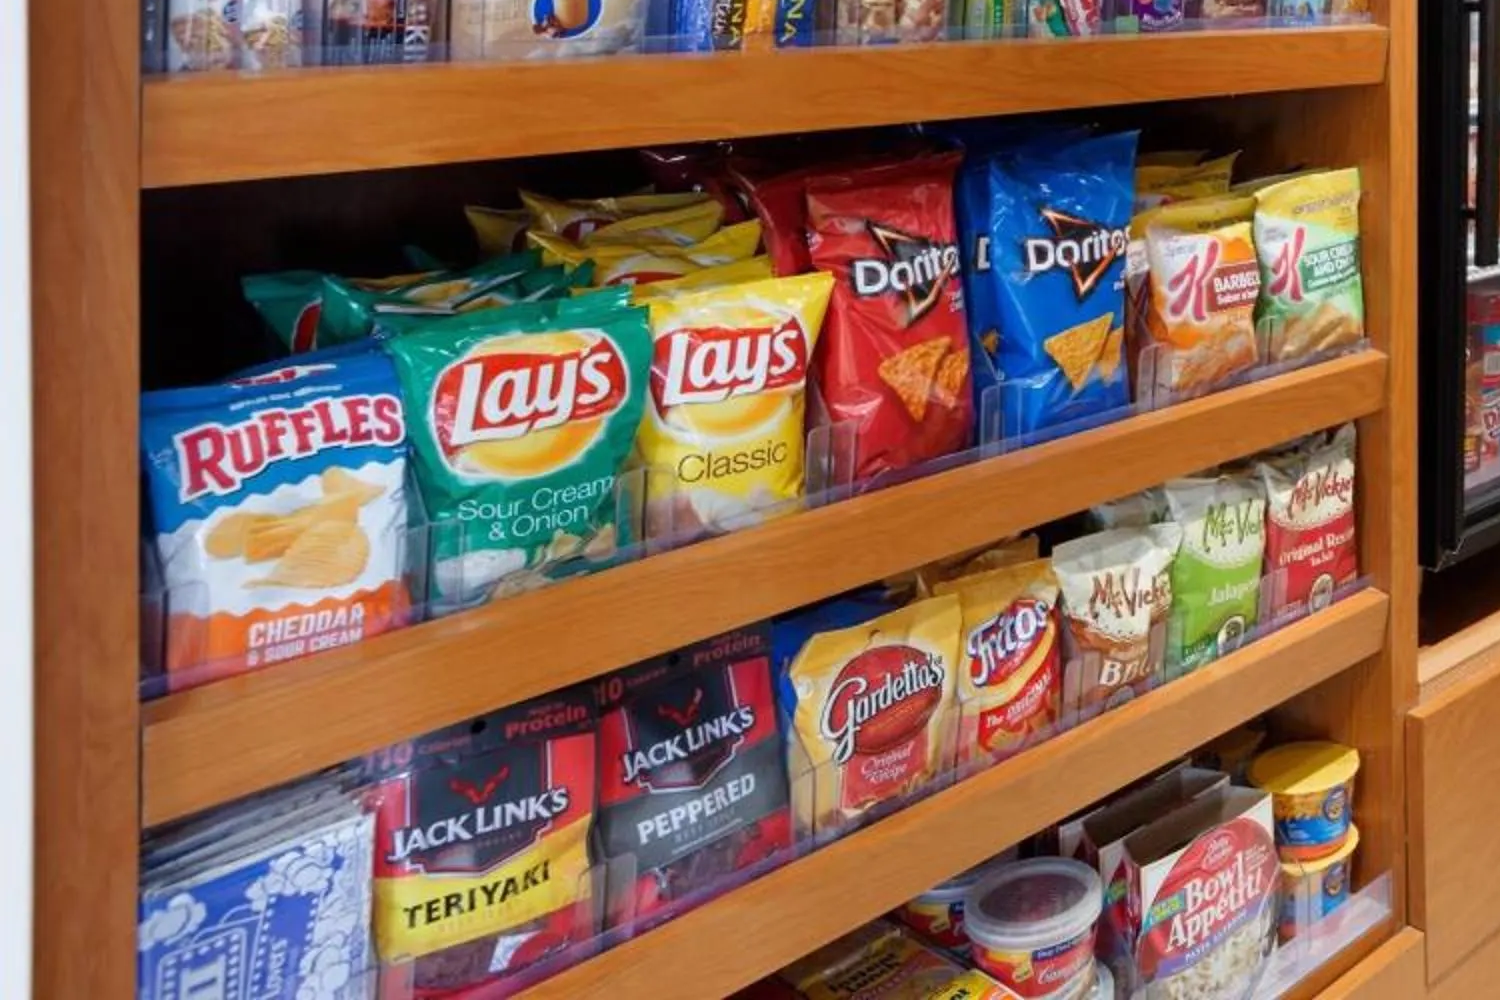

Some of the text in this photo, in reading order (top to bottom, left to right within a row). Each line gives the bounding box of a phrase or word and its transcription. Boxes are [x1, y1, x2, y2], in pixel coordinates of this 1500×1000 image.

[852, 245, 960, 295] Dorito
[448, 347, 612, 447] Lay's
[663, 317, 799, 406] Lay's
[181, 397, 402, 497] RUFFLES
[677, 440, 788, 484] Classic
[457, 474, 616, 522] Sour Cream
[488, 504, 590, 542] & Onion
[248, 605, 364, 648] CHEDDAR
[967, 600, 1048, 686] Fritos
[623, 705, 756, 784] JACK LINK'S
[820, 653, 945, 765] Gardetto's
[388, 786, 568, 864] JACK LINK'S
[636, 772, 756, 846] PEPPERED
[403, 859, 550, 930] TERIYAKI
[1184, 850, 1244, 916] Bowl
